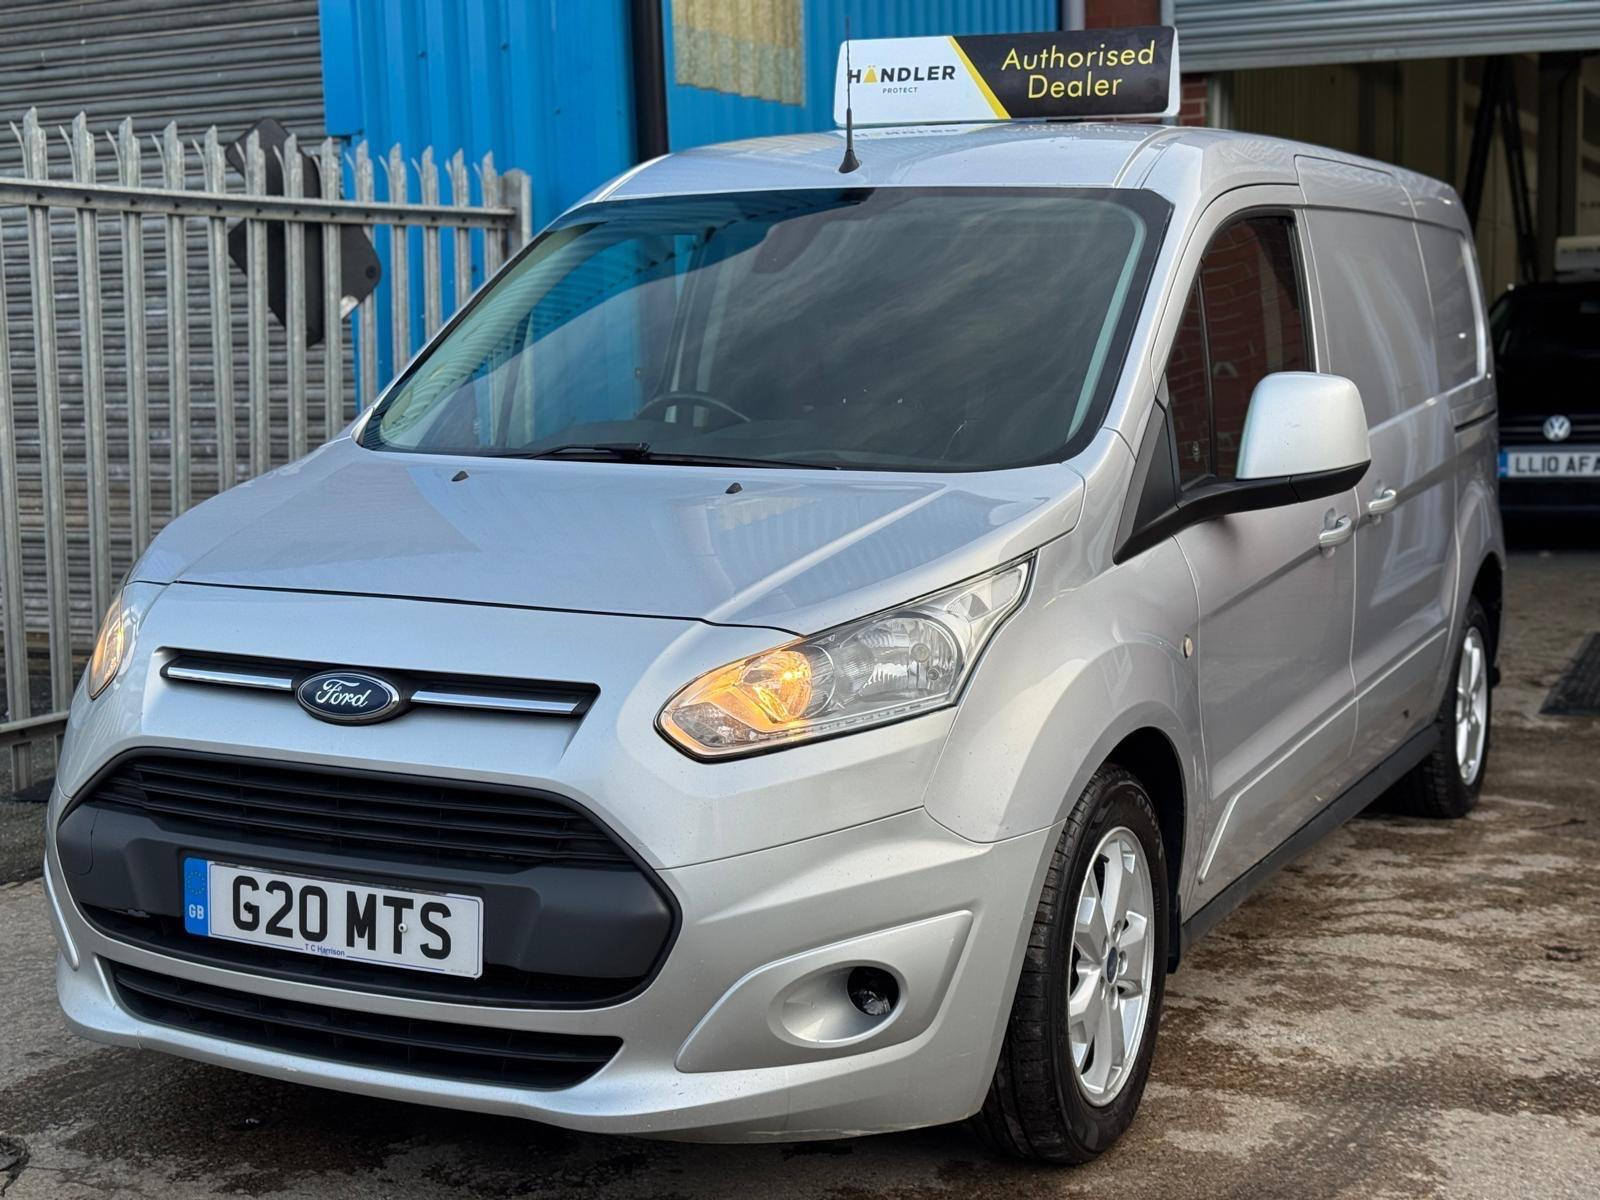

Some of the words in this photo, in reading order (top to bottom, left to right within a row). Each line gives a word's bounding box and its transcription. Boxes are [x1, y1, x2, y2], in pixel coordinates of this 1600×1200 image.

[1001, 39, 1156, 72] Authorised
[882, 86, 919, 94] PROTECT
[1028, 70, 1123, 99] Dealer
[1515, 455, 1560, 474] LL10
[315, 679, 372, 708] Ford
[188, 903, 205, 920] GB
[232, 874, 329, 943] G20
[346, 890, 453, 961] MTS
[305, 943, 309, 951] T
[310, 944, 316, 952] C
[317, 945, 345, 957] Harrison
